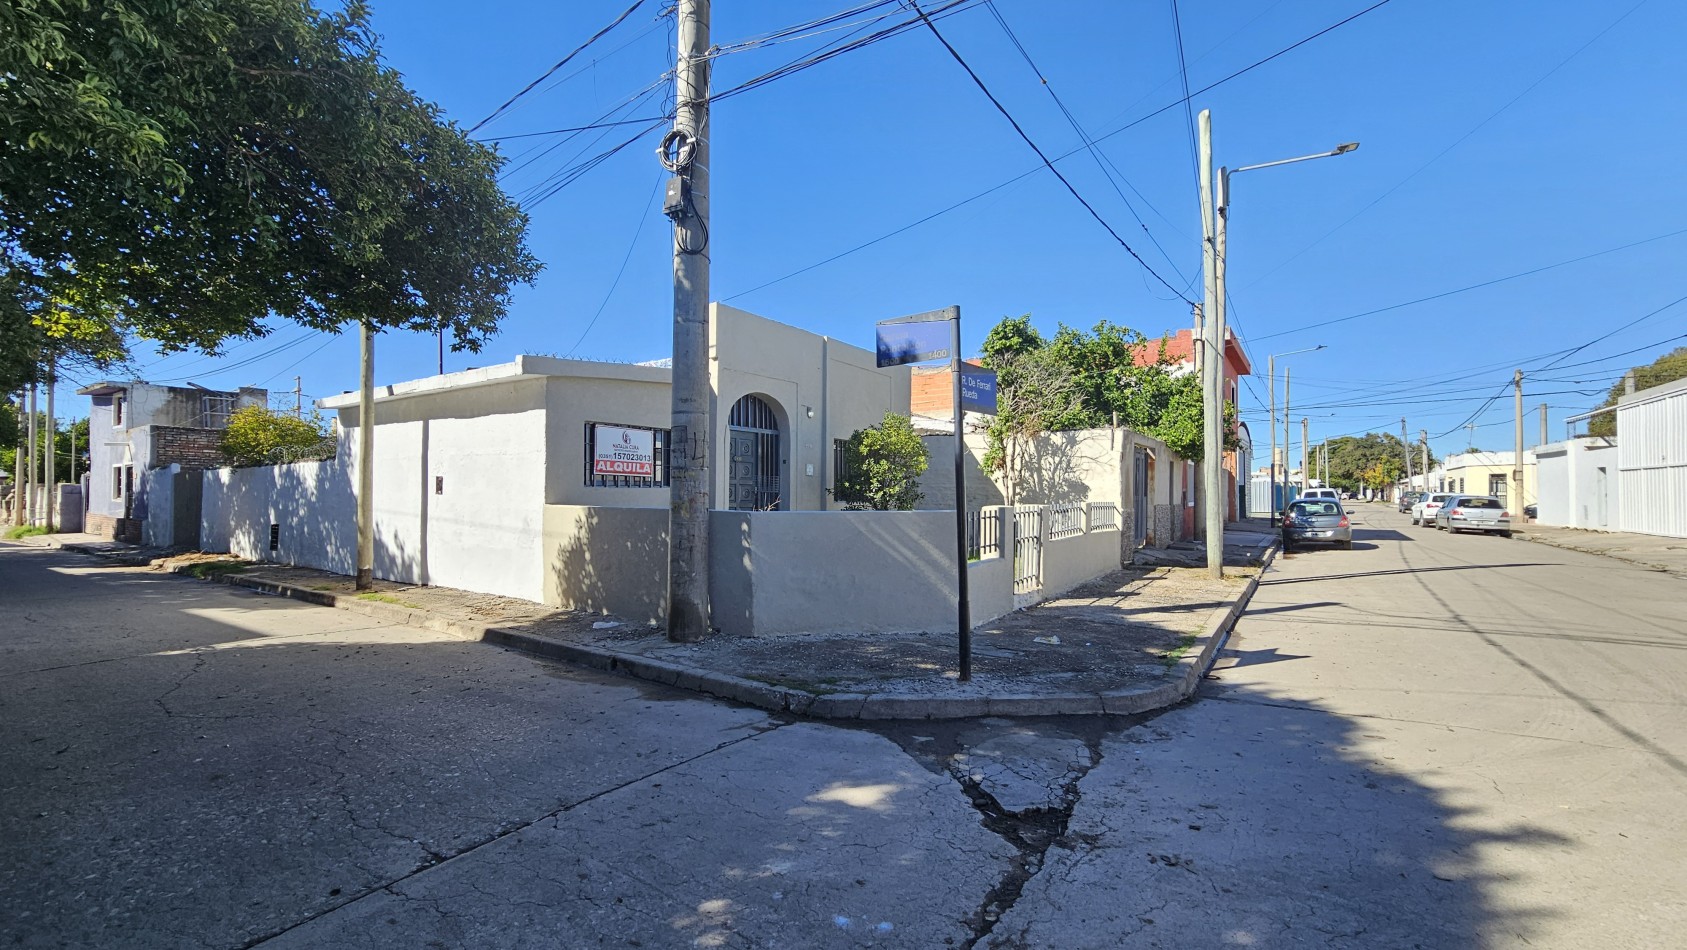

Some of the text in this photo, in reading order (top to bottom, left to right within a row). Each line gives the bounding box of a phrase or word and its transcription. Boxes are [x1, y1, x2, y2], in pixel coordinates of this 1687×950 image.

[928, 350, 947, 360] 1400
[961, 375, 967, 385] R.
[968, 377, 976, 387] De
[962, 387, 978, 400] Rueda
[613, 452, 651, 462] 157023013
[596, 460, 651, 473] ALQUILA
